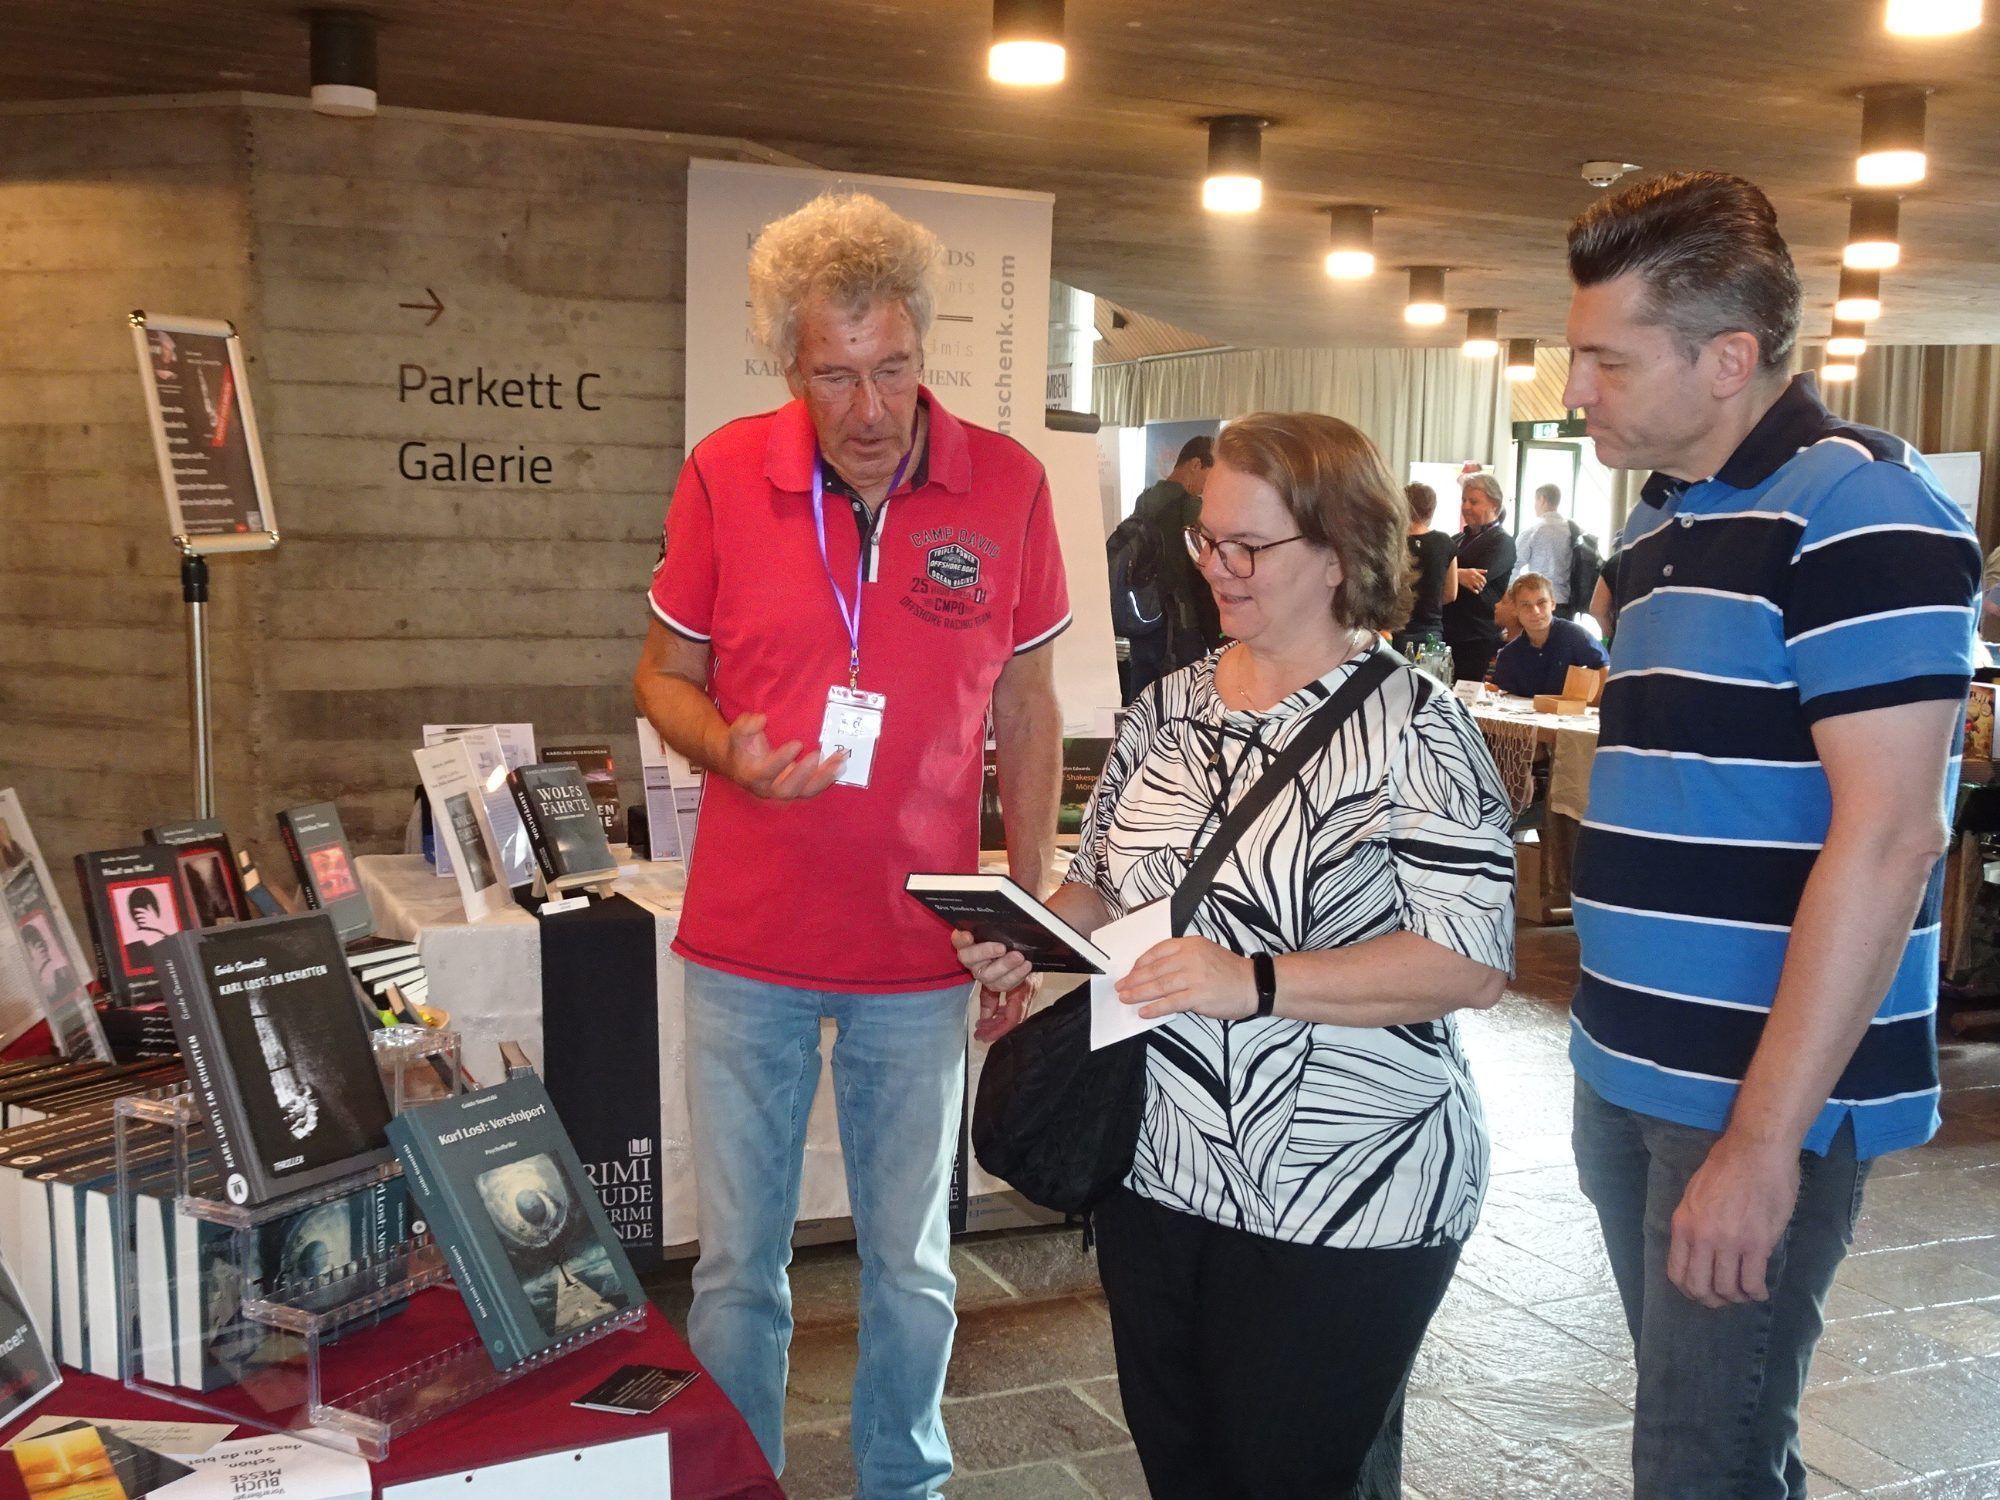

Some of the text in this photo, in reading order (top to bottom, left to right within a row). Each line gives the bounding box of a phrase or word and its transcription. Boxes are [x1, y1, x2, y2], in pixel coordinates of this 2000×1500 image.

[947, 250, 975, 267] DS
[995, 254, 1016, 435] nschenk.com
[744, 359, 972, 387] KAR HENK
[398, 363, 601, 411] Parkett C
[398, 441, 553, 484] Galerie
[911, 527, 953, 548] CAMP
[934, 547, 954, 558] TRIPLE
[930, 560, 977, 573] OFFSHORE BOAT
[911, 578, 929, 594] 25
[931, 570, 974, 587] OCEAN RACING
[900, 596, 942, 626] OFFSHORE
[934, 598, 965, 615] CMPO
[984, 765, 997, 775] urg
[537, 785, 583, 800] WOLFS
[540, 798, 590, 816] FÄHRTE
[597, 804, 615, 815] EN
[219, 964, 328, 995] KARL LOST: IM SCHATTEN
[187, 1035, 235, 1168] KARL LOST: IM SCHATTEN
[438, 1103, 547, 1146] Karl Lost: Verstolpert
[582, 1158, 652, 1187] RIMI
[597, 1184, 653, 1206] UDE
[607, 1206, 652, 1222] RIMI
[613, 1223, 653, 1240] NDE
[220, 1452, 239, 1460] da
[244, 1448, 262, 1456] du
[268, 1443, 301, 1453] dass
[229, 1468, 281, 1482] MESSE
[234, 1477, 279, 1492] BUCH
